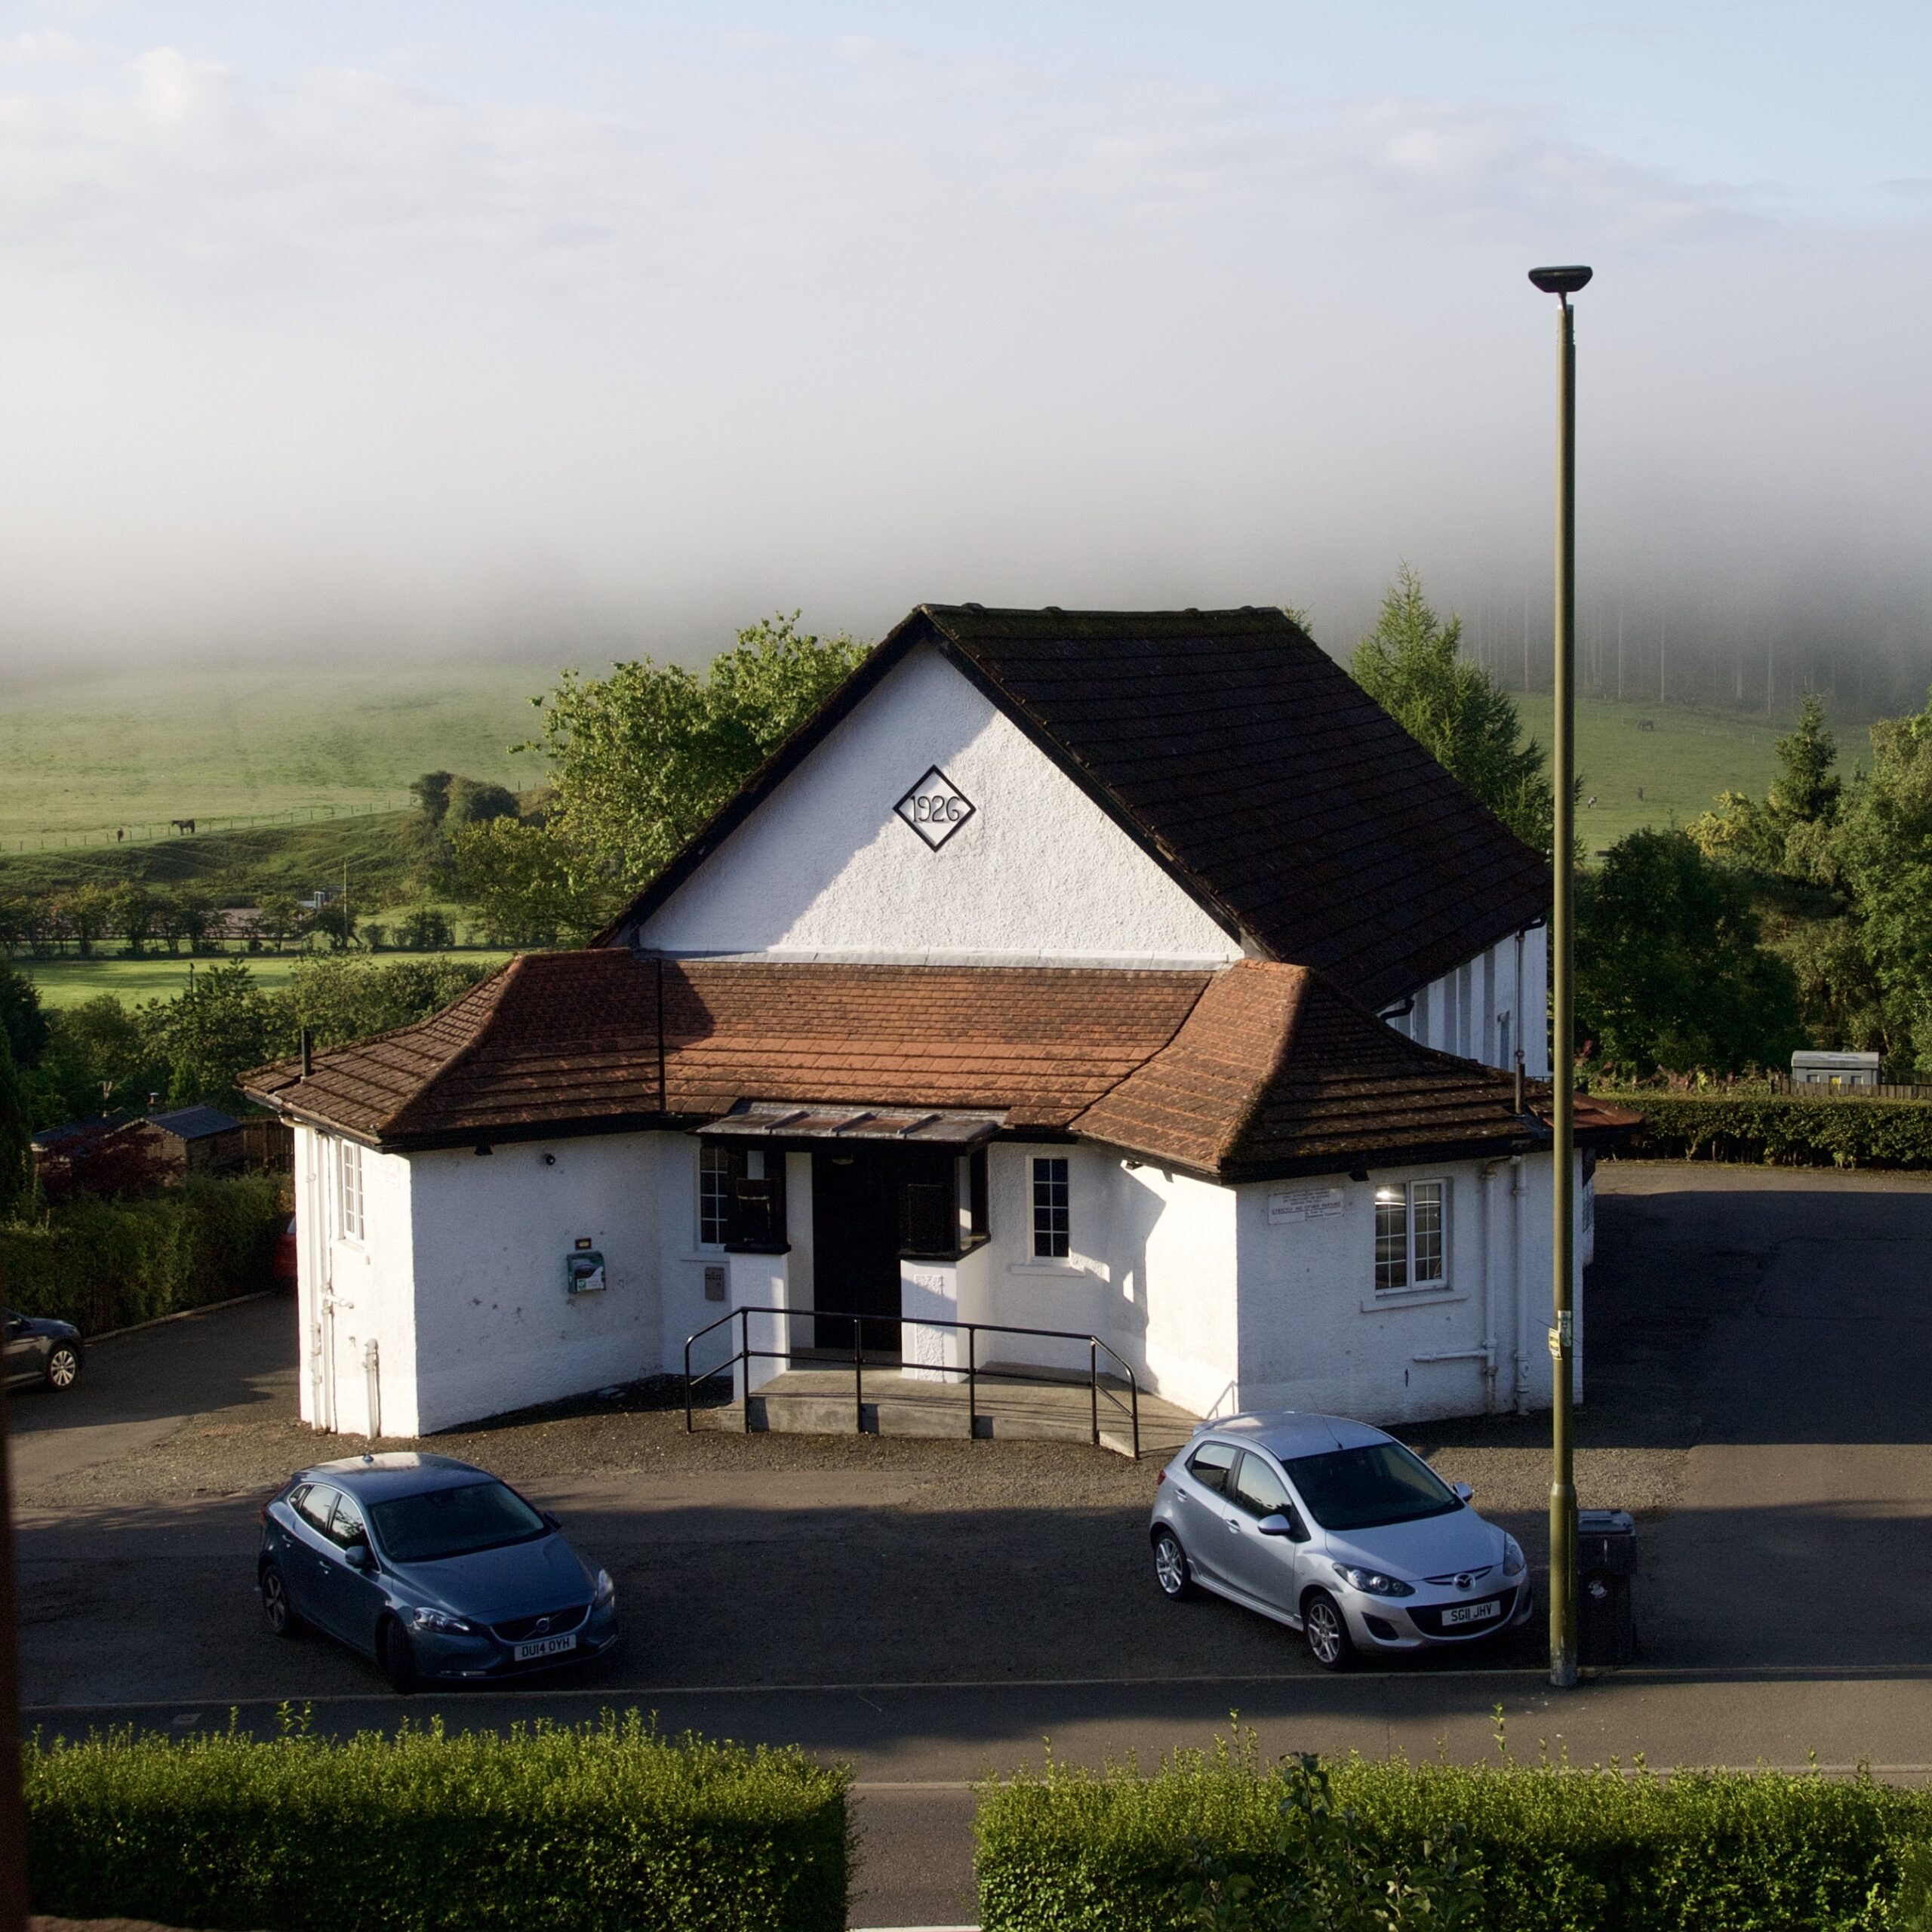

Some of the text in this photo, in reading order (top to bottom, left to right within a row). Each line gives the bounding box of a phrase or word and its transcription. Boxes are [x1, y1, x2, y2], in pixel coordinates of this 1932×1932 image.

[909, 795, 960, 822] 1926
[1451, 1603, 1492, 1622] SG11 JHV
[522, 1637, 570, 1657] DU14 OYH
